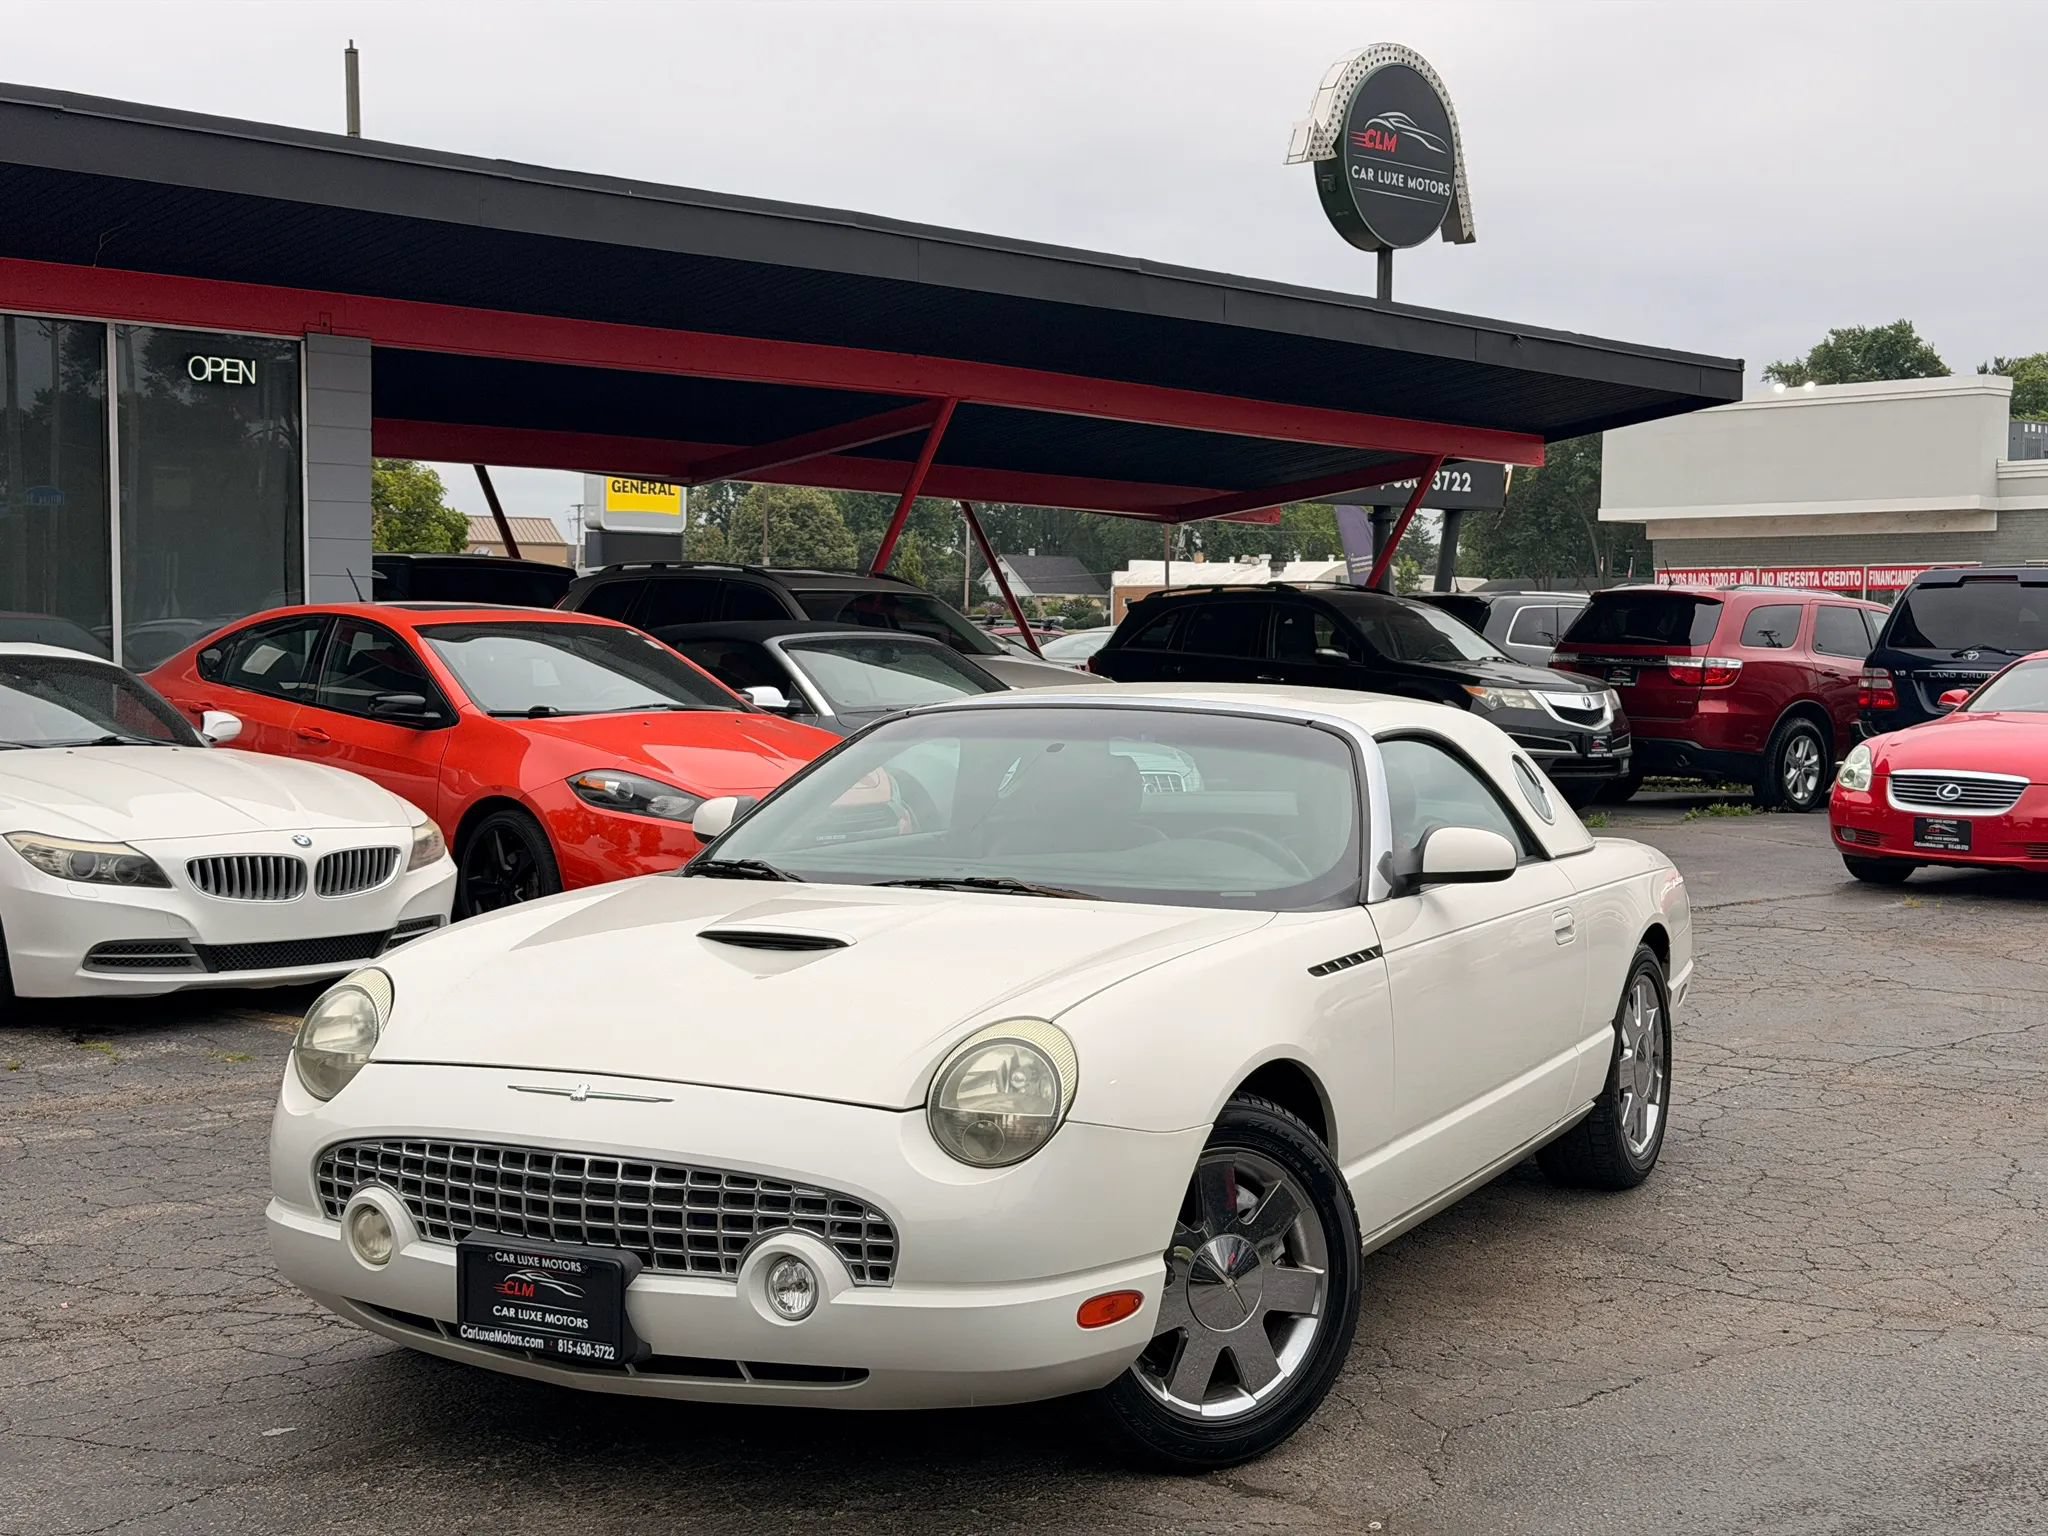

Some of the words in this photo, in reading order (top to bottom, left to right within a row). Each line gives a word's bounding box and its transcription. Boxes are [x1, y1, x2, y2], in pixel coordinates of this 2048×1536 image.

[1365, 129, 1398, 153] CLM
[1351, 165, 1375, 182] CAR
[1377, 170, 1405, 188] LUXE
[1407, 175, 1451, 197] MOTORS
[187, 355, 256, 385] OPEN
[611, 479, 676, 496] GENERAL
[1710, 572, 1729, 586] TODO
[1729, 572, 1738, 585] EL
[1761, 571, 1775, 586] NO
[1776, 571, 1821, 587] NECESITA
[1821, 570, 1862, 587] CREDITO
[494, 1251, 516, 1264] CAR
[516, 1254, 540, 1268] LUXE
[541, 1257, 582, 1273] MOTORS
[504, 1281, 535, 1297] CLM
[492, 1305, 515, 1318] CAR
[517, 1308, 543, 1322] LUXE
[544, 1313, 589, 1329] MOTORS
[459, 1324, 544, 1350] CarLuxeMotors.com
[557, 1339, 615, 1360] 815-630-3722
